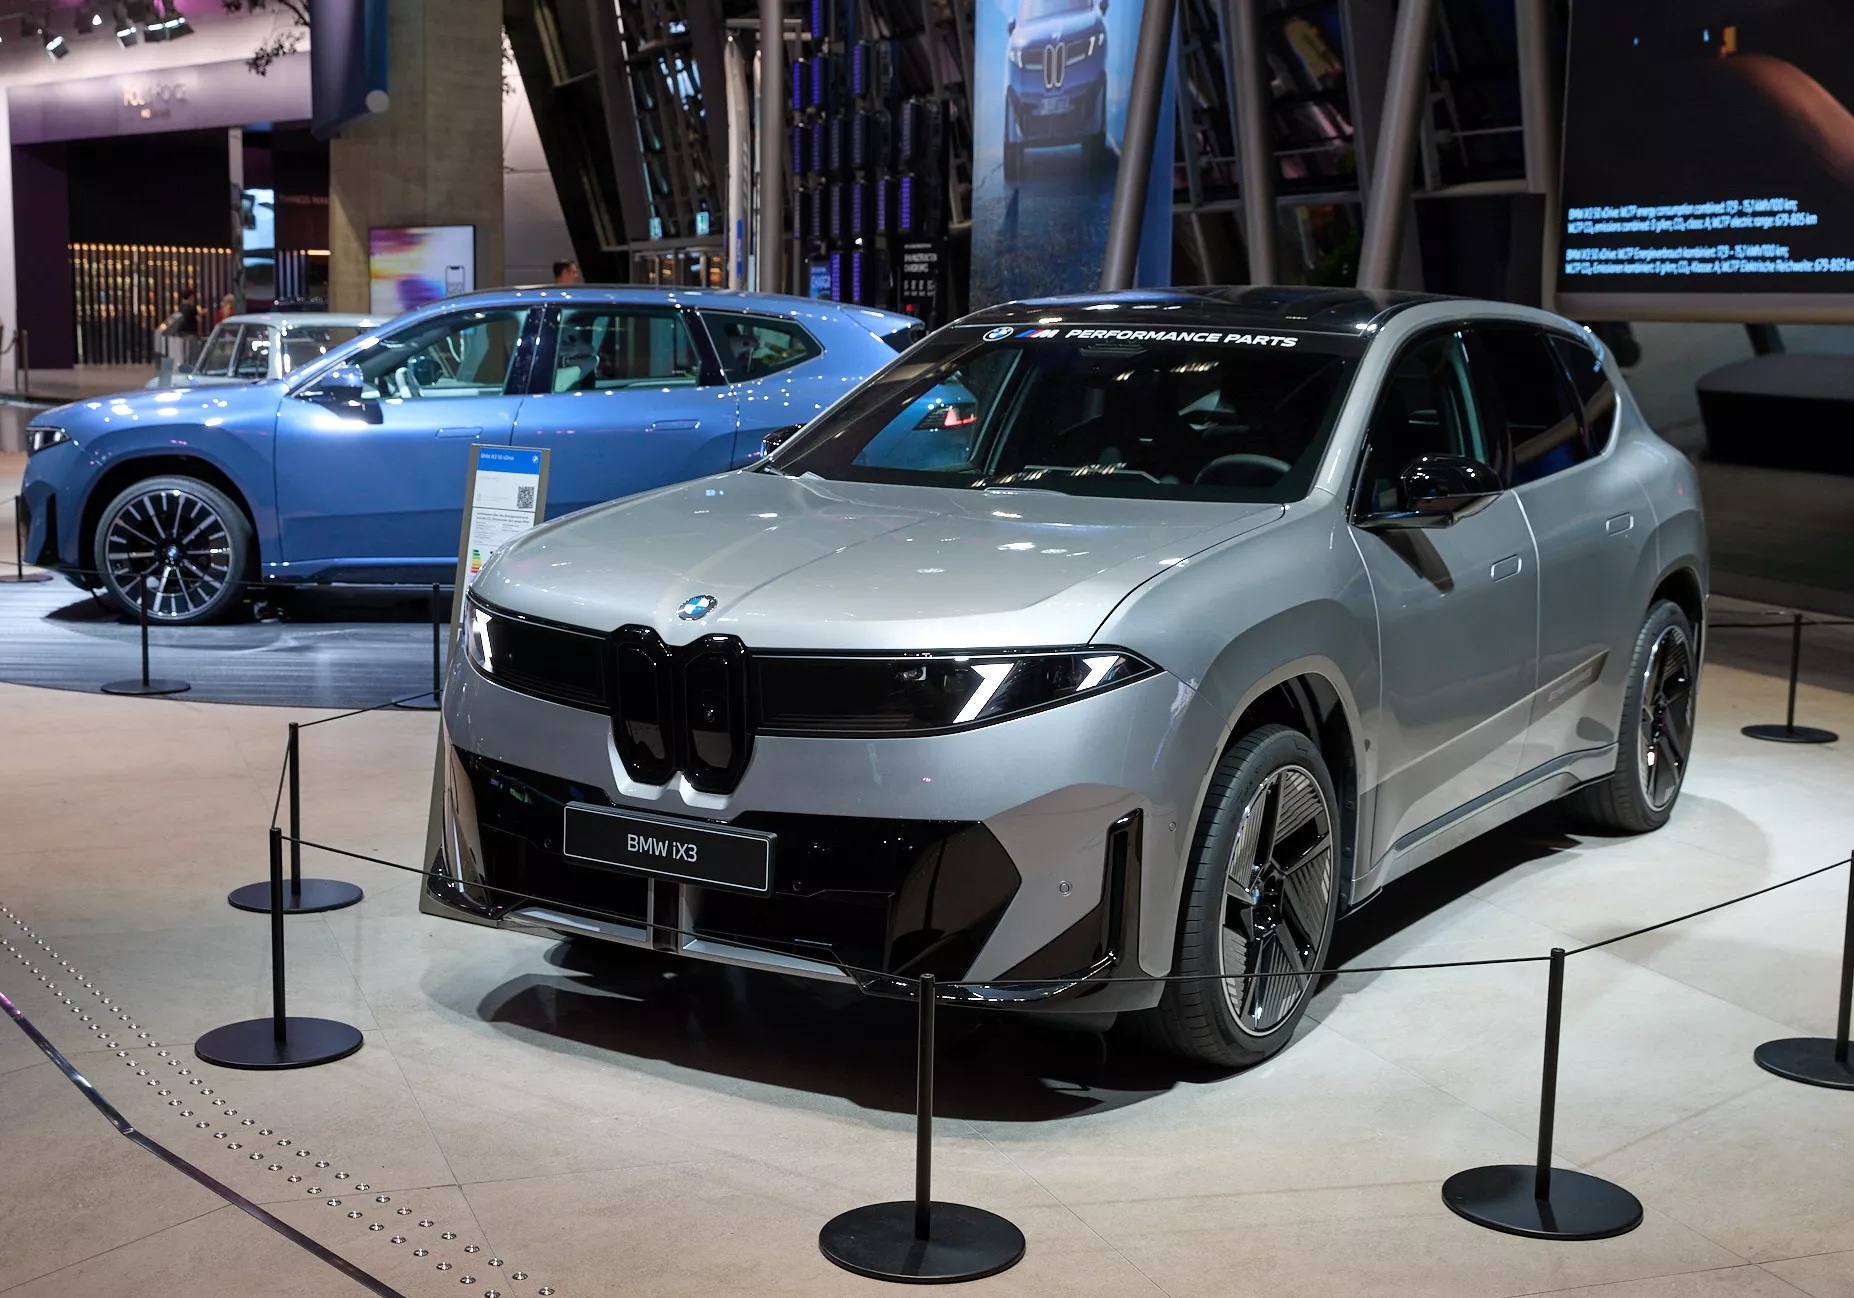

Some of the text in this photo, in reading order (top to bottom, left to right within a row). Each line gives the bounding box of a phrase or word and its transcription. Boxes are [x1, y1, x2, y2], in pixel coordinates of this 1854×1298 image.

[1065, 329, 1223, 343] PERFORMANCE
[1223, 333, 1299, 348] PARTS
[627, 834, 698, 862] BMW iX3
